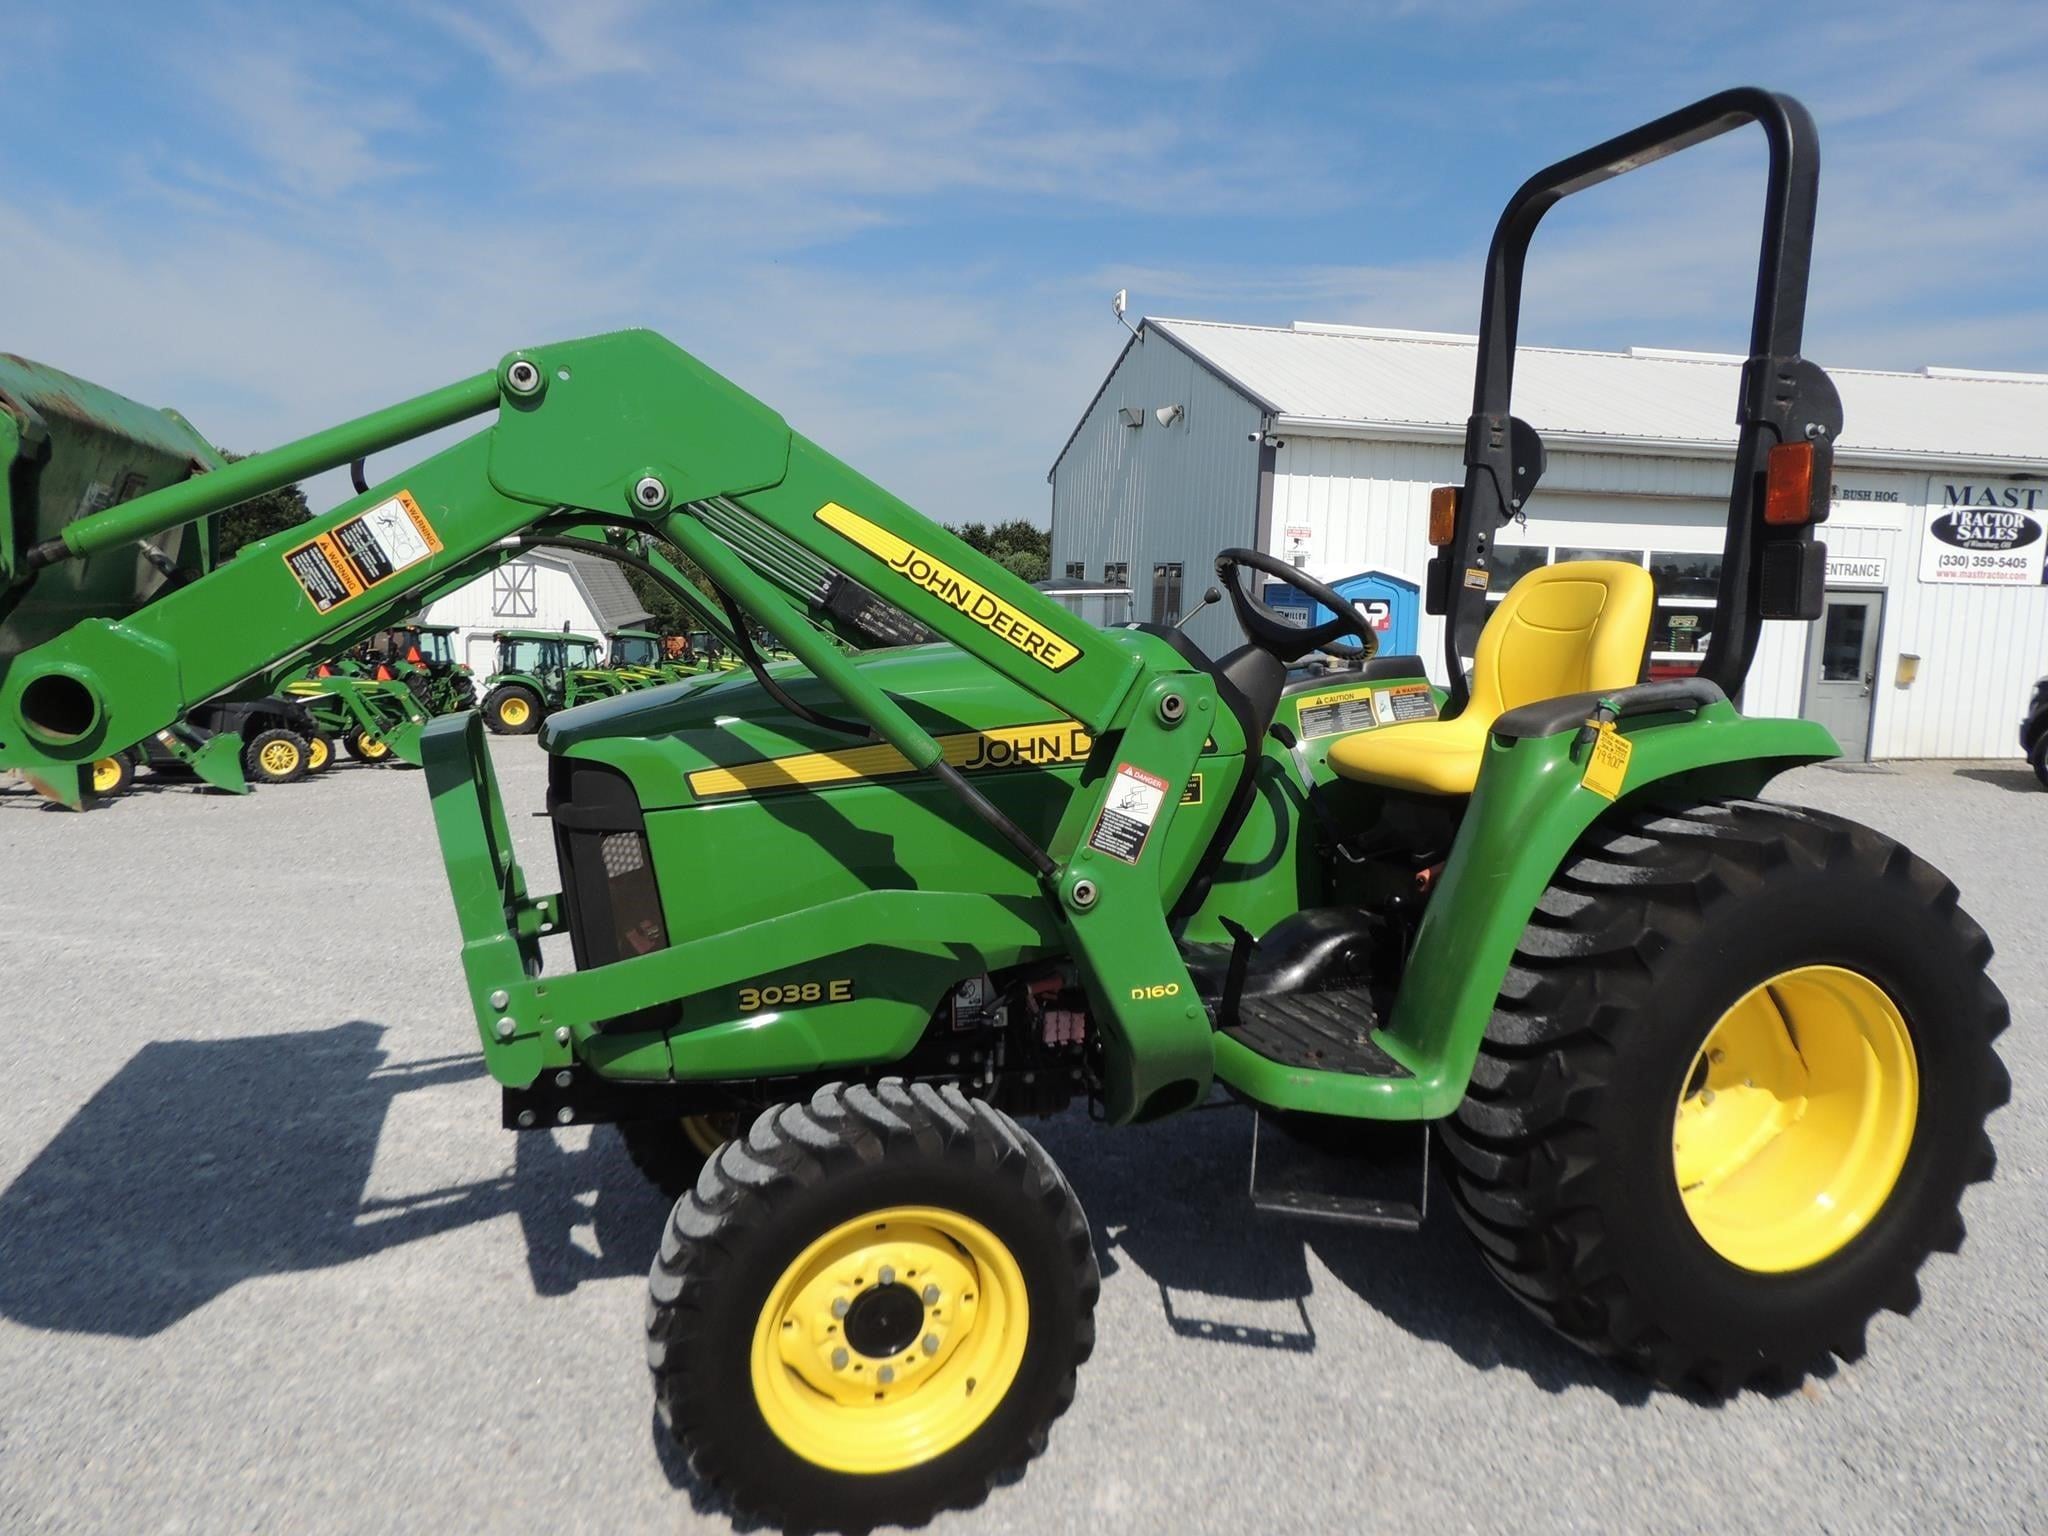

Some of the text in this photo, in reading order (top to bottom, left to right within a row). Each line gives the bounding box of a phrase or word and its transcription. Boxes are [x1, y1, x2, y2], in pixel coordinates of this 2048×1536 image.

[1843, 489, 1899, 502] BUSH HOG
[1942, 484, 2043, 512] MAST
[409, 506, 436, 546] WARNING
[1949, 510, 2025, 528] TRACTOR
[1956, 525, 2018, 541] SALES
[1938, 554, 2027, 569] (330) 359-5405
[328, 551, 356, 590] WARNING
[890, 550, 1062, 665] JOHN DEERE
[1284, 612, 1307, 620] MILLER
[1323, 693, 1355, 704] CAUTION
[965, 735, 1060, 766] JOHN
[1133, 771, 1162, 788] DANGER
[739, 979, 851, 1011] 3038 E
[1131, 983, 1179, 1000] D160
